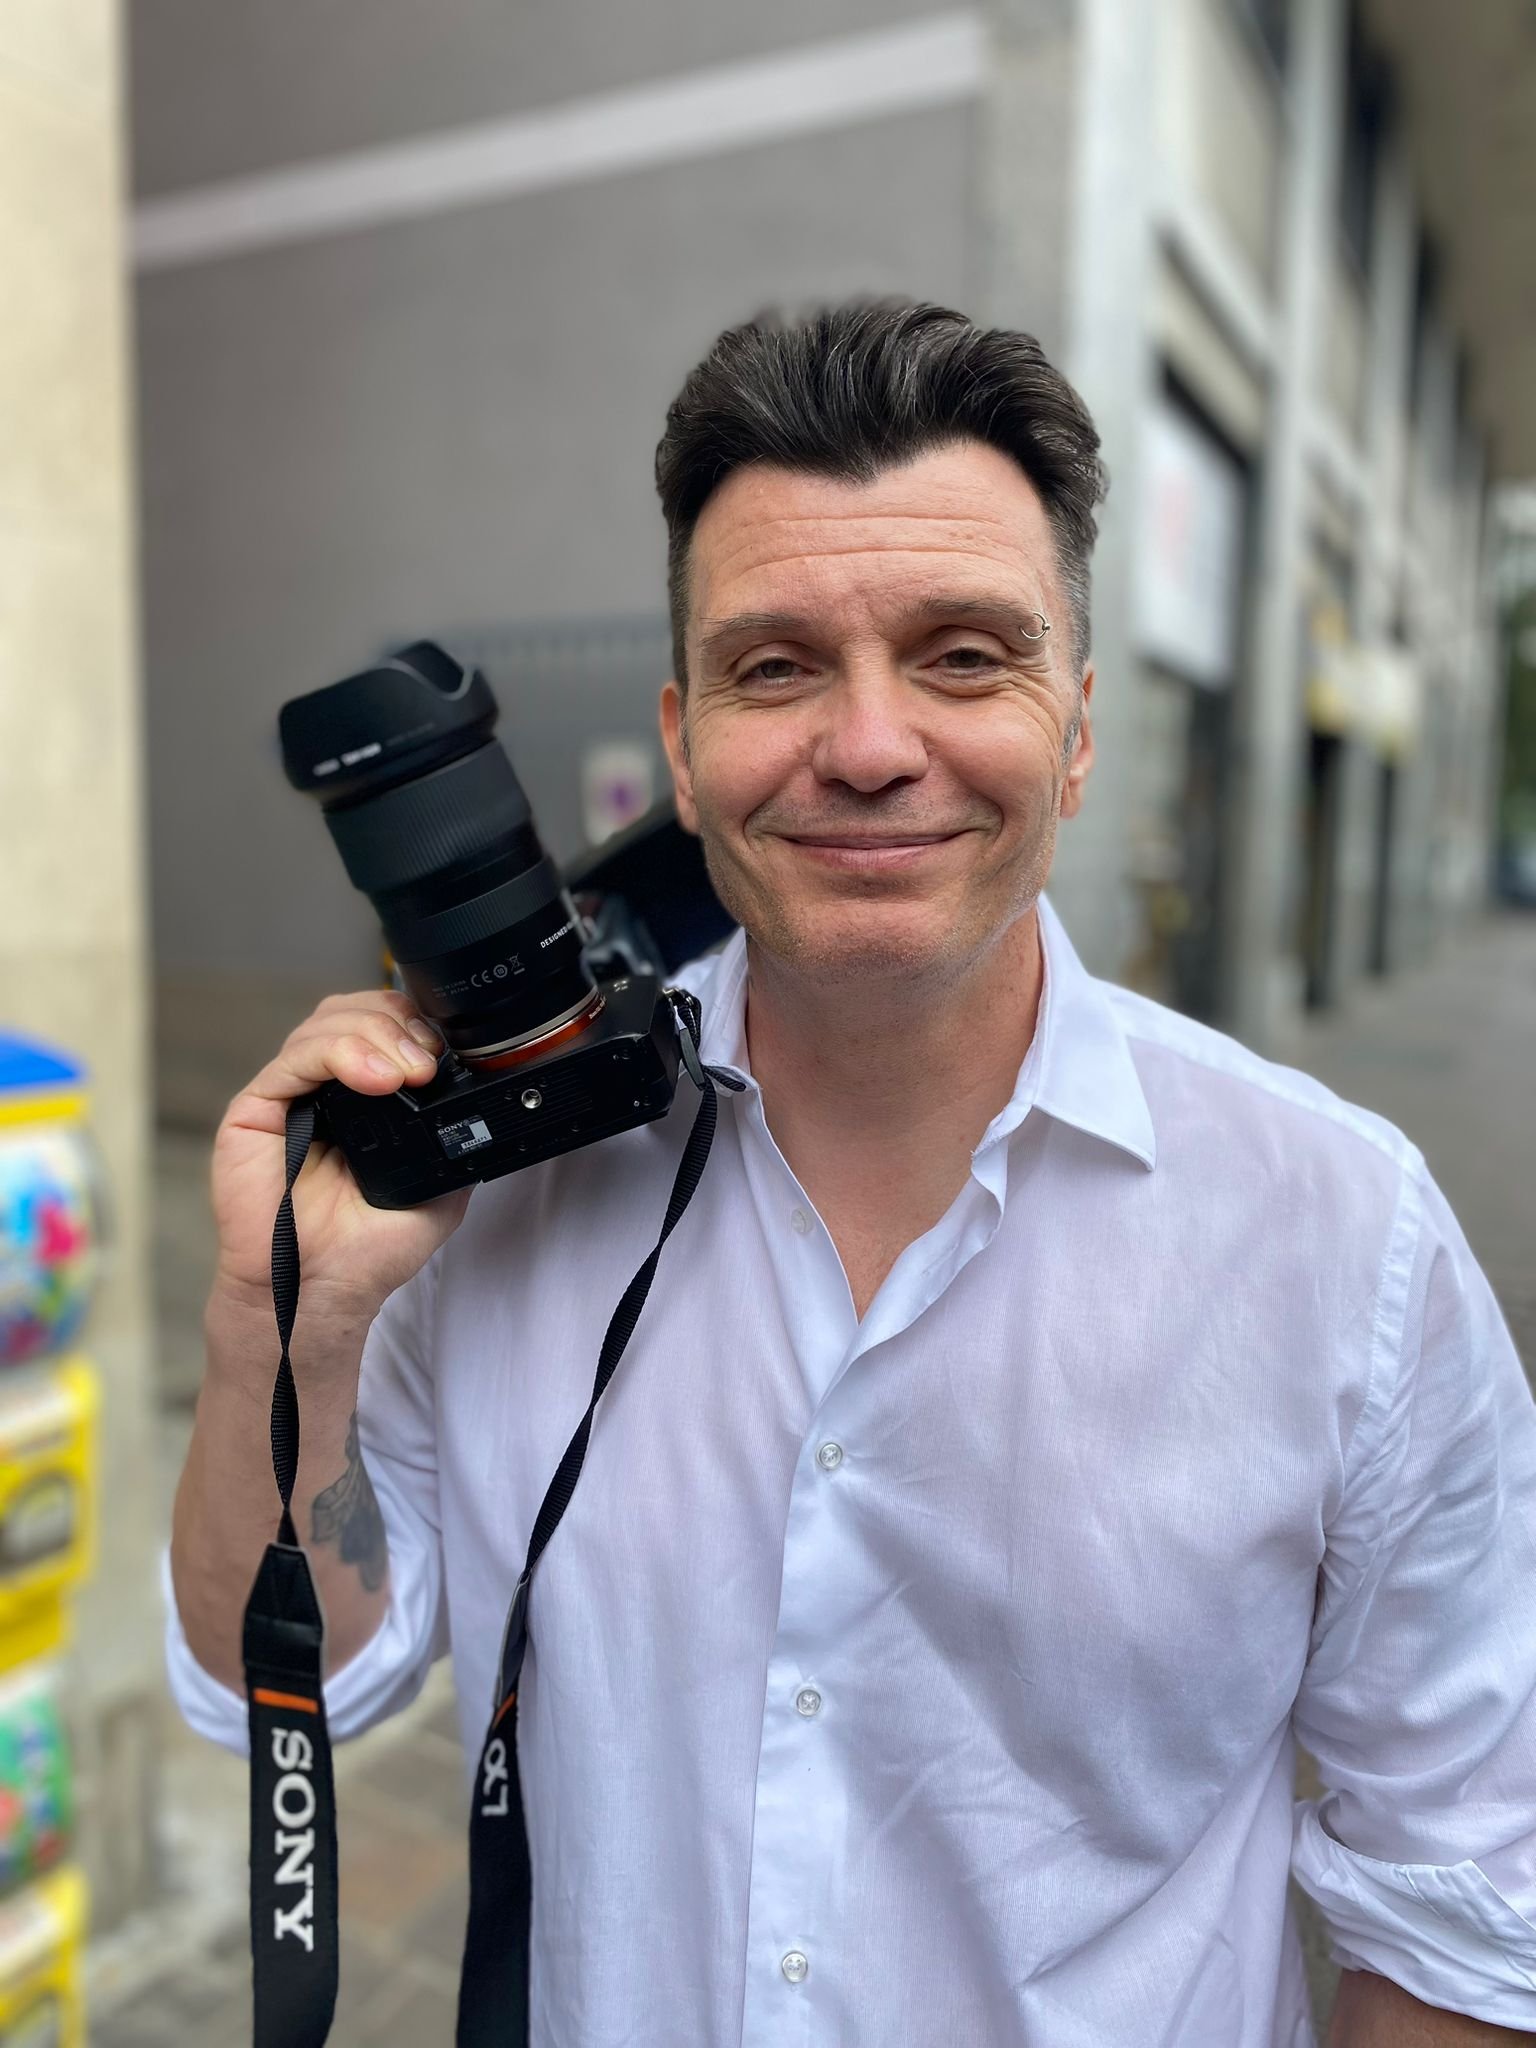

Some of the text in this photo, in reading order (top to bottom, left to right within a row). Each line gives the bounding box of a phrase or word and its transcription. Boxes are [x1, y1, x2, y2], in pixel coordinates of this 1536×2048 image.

[540, 926, 568, 949] DESIGNED
[471, 970, 493, 988] CE
[437, 1122, 463, 1135] SONY
[271, 1727, 315, 1952] SONY
